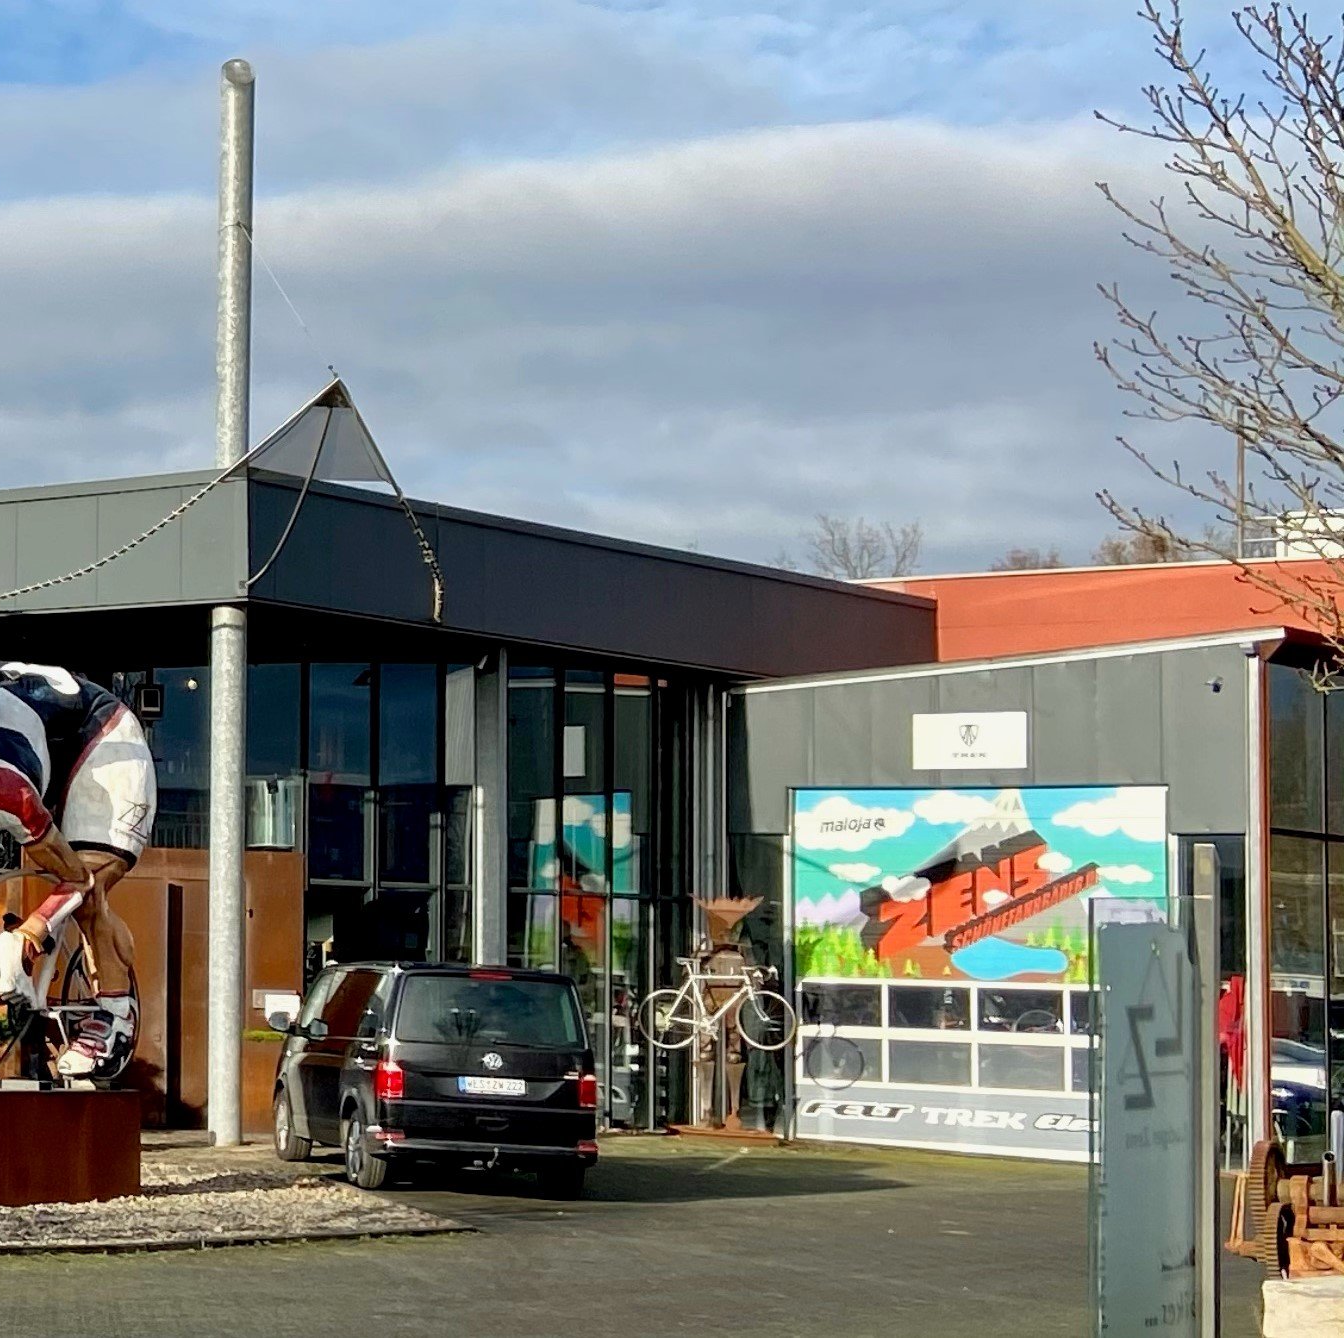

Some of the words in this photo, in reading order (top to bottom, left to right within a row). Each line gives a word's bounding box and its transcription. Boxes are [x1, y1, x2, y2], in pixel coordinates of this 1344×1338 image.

[820, 817, 872, 832] maloja
[865, 836, 1048, 960] ZENS
[801, 1101, 914, 1122] FELT
[921, 1106, 1027, 1130] TREK
